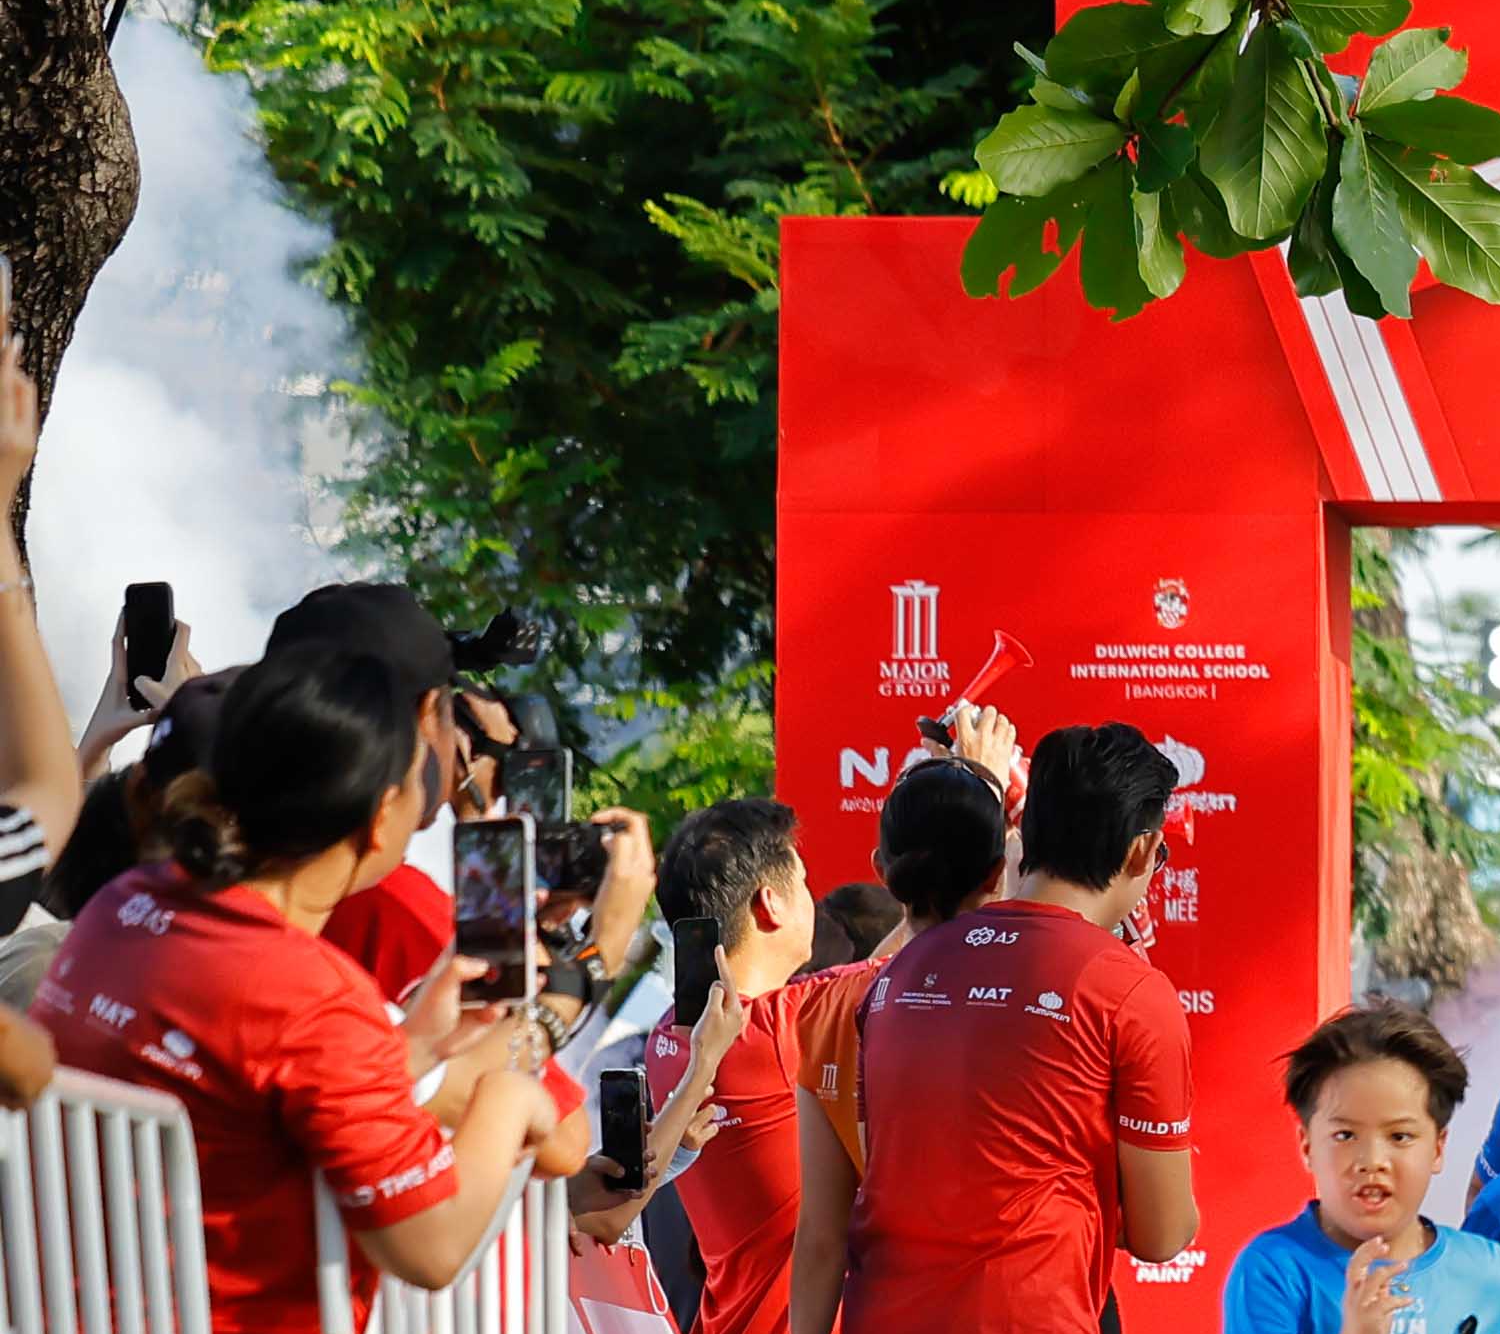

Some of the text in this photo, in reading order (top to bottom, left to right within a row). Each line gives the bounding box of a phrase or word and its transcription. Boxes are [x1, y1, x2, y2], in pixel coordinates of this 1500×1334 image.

[1095, 644, 1246, 659] DULWICH COLLEGE
[879, 661, 951, 680] MAJOR
[1071, 664, 1270, 679] INTERNATIONAL SCHOOL
[879, 683, 951, 696] GROUP
[1165, 898, 1198, 922] MEE
[994, 931, 1020, 944] A5
[968, 987, 1012, 1001] NAT
[1178, 990, 1215, 1013] SIS
[89, 994, 136, 1028] NAT
[1024, 1005, 1071, 1023] PUMPKIN
[1120, 1115, 1168, 1135] BUILD
[1136, 1267, 1193, 1283] PAINT
